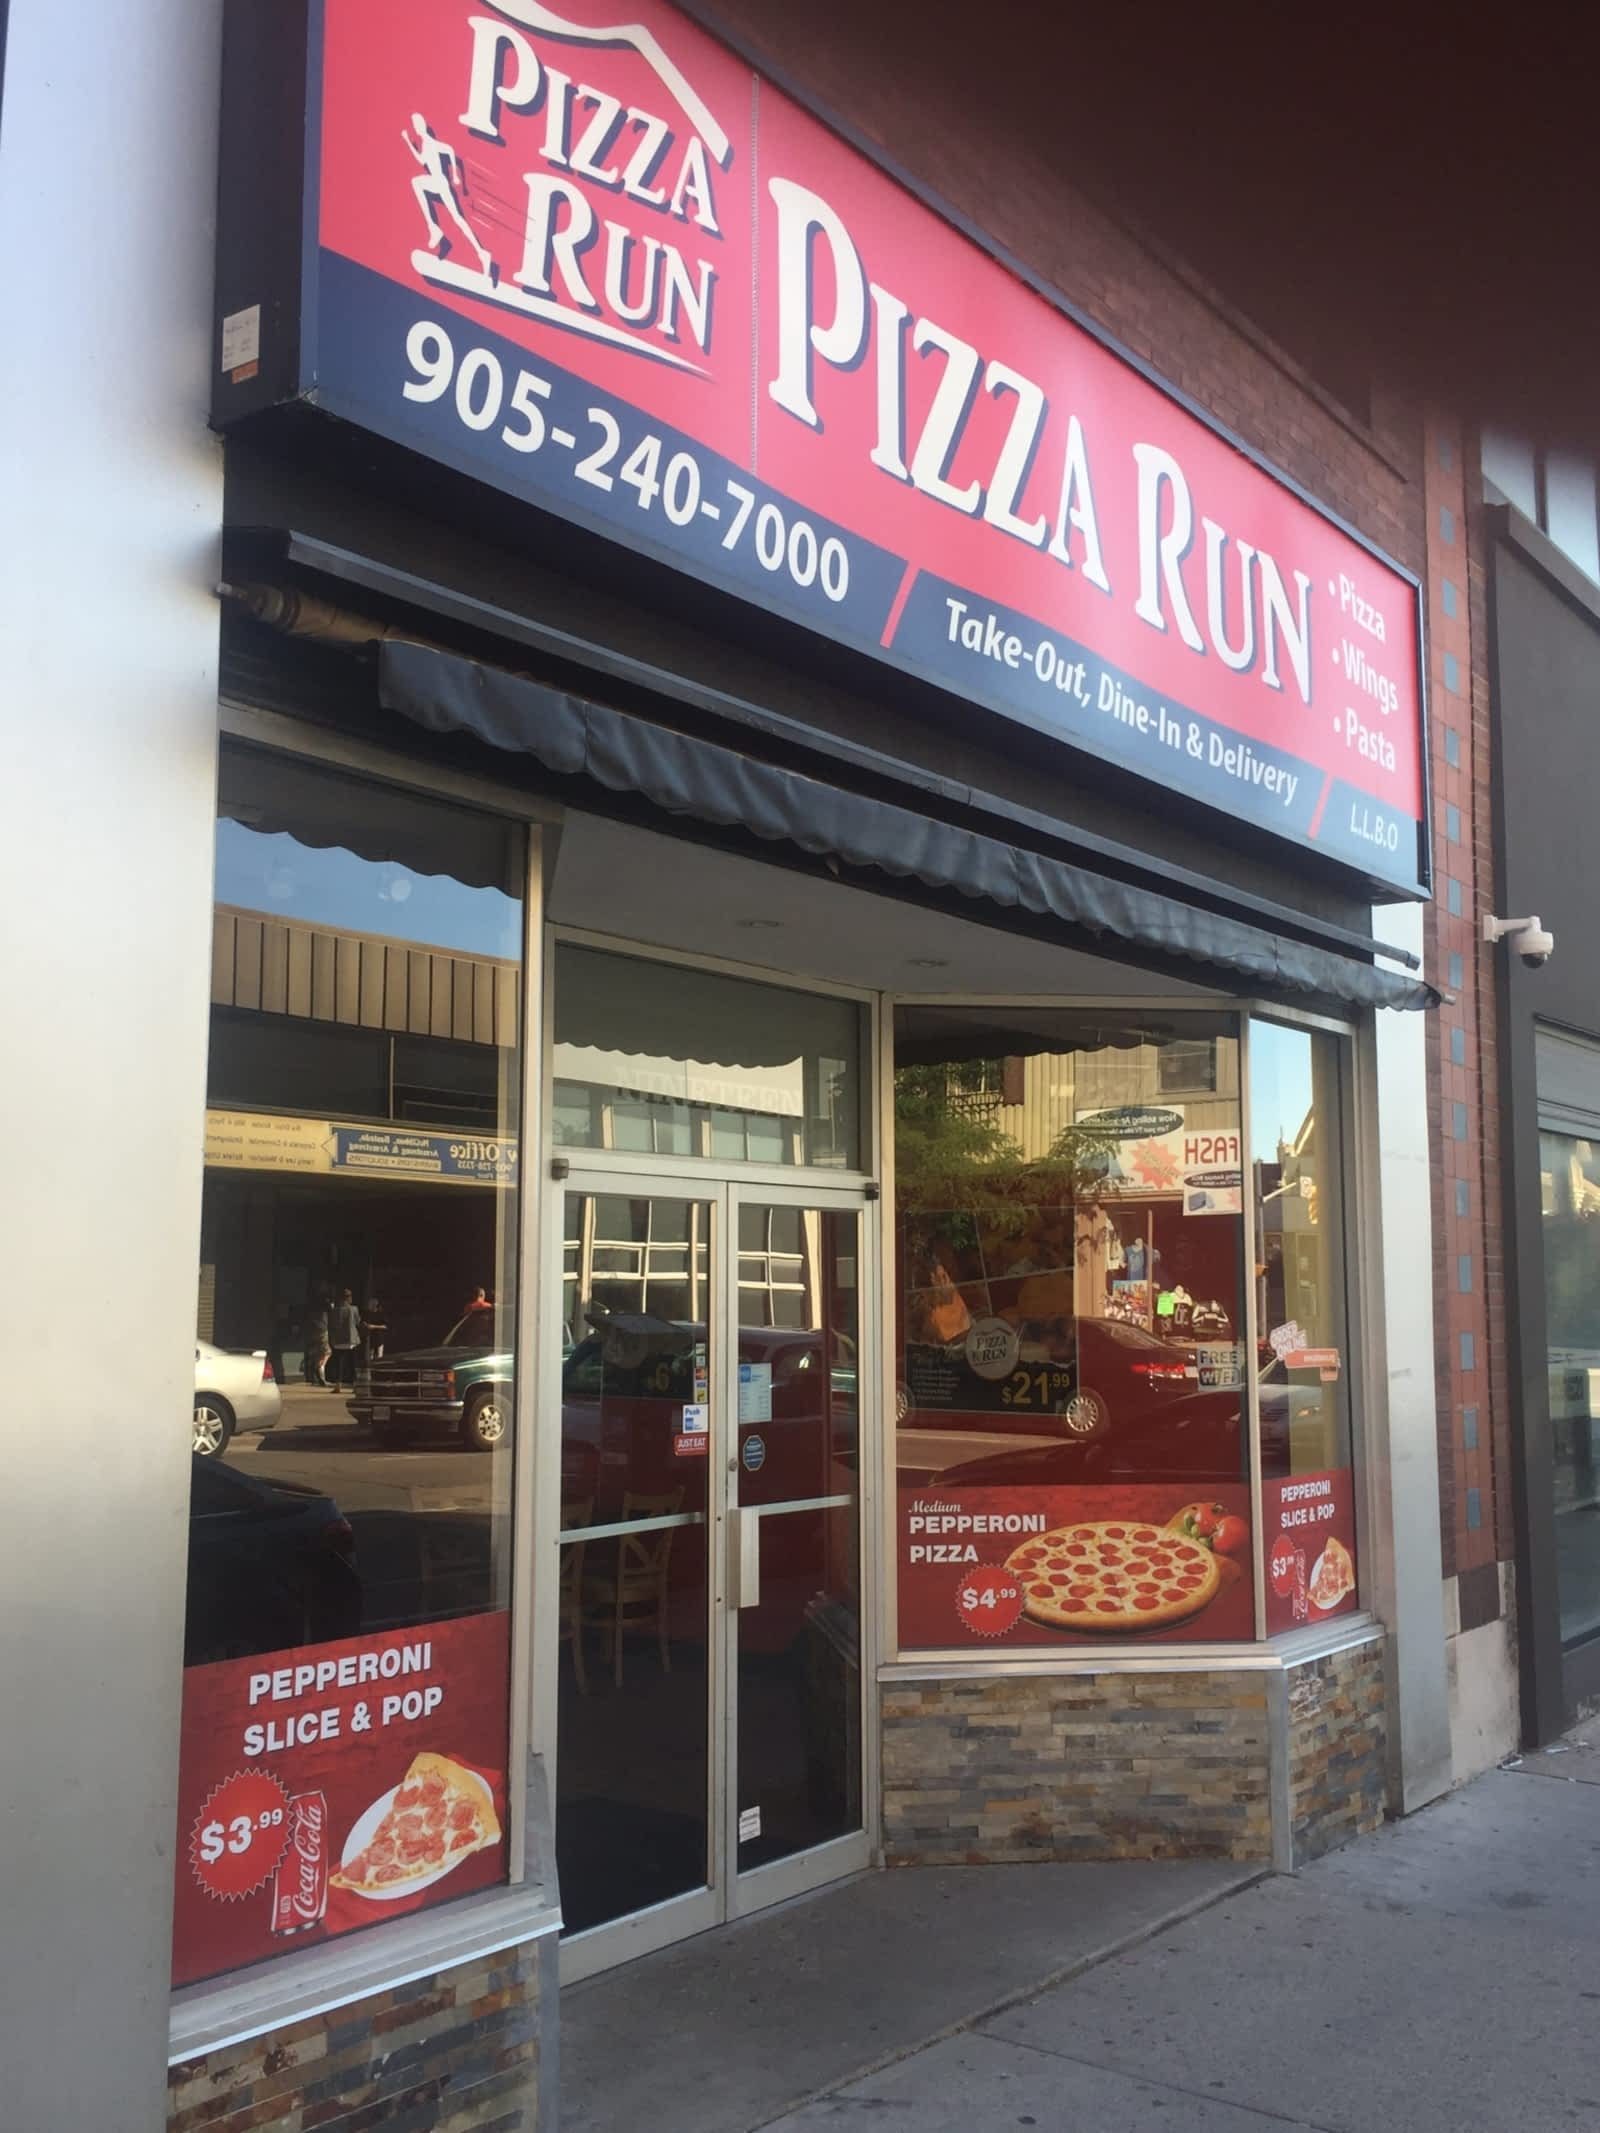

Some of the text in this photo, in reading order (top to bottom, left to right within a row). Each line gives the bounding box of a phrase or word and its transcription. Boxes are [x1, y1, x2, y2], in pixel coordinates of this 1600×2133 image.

[459, 15, 721, 234] PIZZA
[513, 172, 716, 348] RUN
[402, 321, 850, 602] 905-240-7000
[768, 176, 1311, 705] PIZZA RUN
[1339, 572, 1385, 641] Pizza
[946, 597, 1299, 806] Take-Out, Dine-In & Delivery
[1342, 639, 1399, 715] Wings
[1345, 706, 1396, 774] Pasta
[977, 1336, 1007, 1349] PIZZA
[1200, 1350, 1238, 1364] FREE
[678, 1436, 706, 1450] JUST EAT
[908, 1500, 961, 1513] Medium
[1281, 1479, 1331, 1503] PEPPERONI
[1281, 1503, 1335, 1529] SLICE & POP
[909, 1514, 1046, 1534] PEPPERONI
[909, 1545, 978, 1564] PIZZA
[962, 1588, 1017, 1611] $4.99
[249, 1642, 432, 1705] PEPPERONI
[243, 1687, 443, 1757] SLICE & POP
[199, 1808, 283, 1864] $3.99
